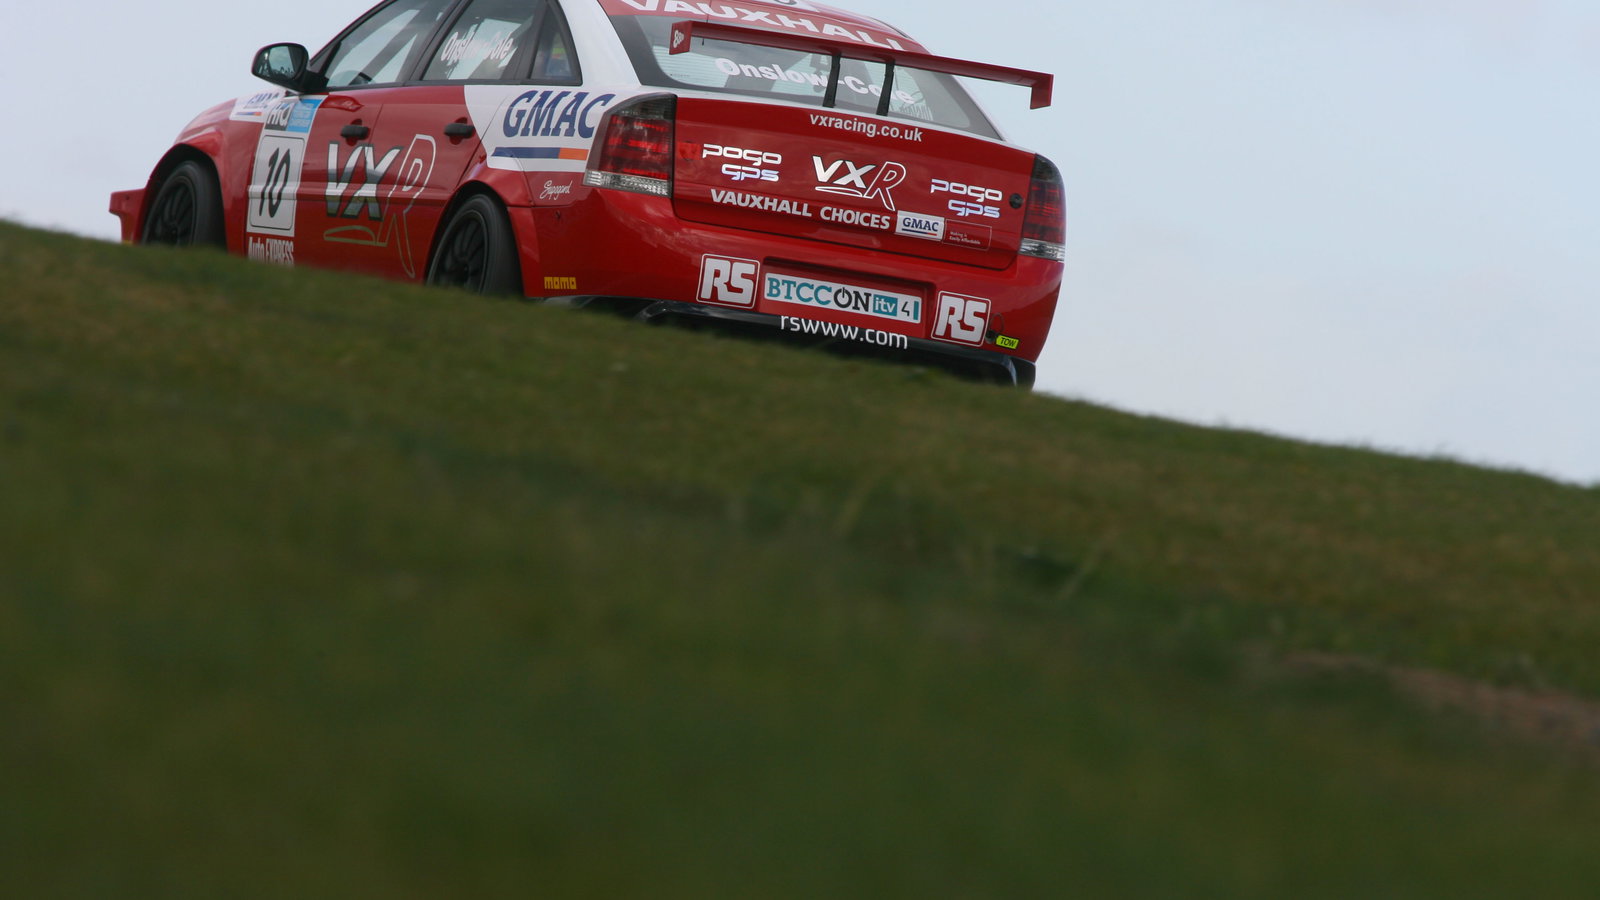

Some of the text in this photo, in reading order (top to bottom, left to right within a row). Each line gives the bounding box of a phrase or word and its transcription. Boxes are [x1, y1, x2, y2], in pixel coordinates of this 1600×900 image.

[621, 0, 908, 52] VAUXHALL
[715, 57, 915, 105] Onslow-Coe
[502, 89, 617, 139] GMAC
[809, 113, 924, 142] vxracing.co.uk
[258, 147, 291, 218] 10
[324, 133, 437, 279] VXR
[812, 155, 907, 212] VXR
[710, 188, 891, 230] VAUXHALL CHOICES
[903, 217, 939, 232] GMAC
[700, 257, 757, 306] RS
[781, 315, 908, 349] rswww.com
[934, 298, 988, 343] RS
[1000, 337, 1017, 347] TOW
